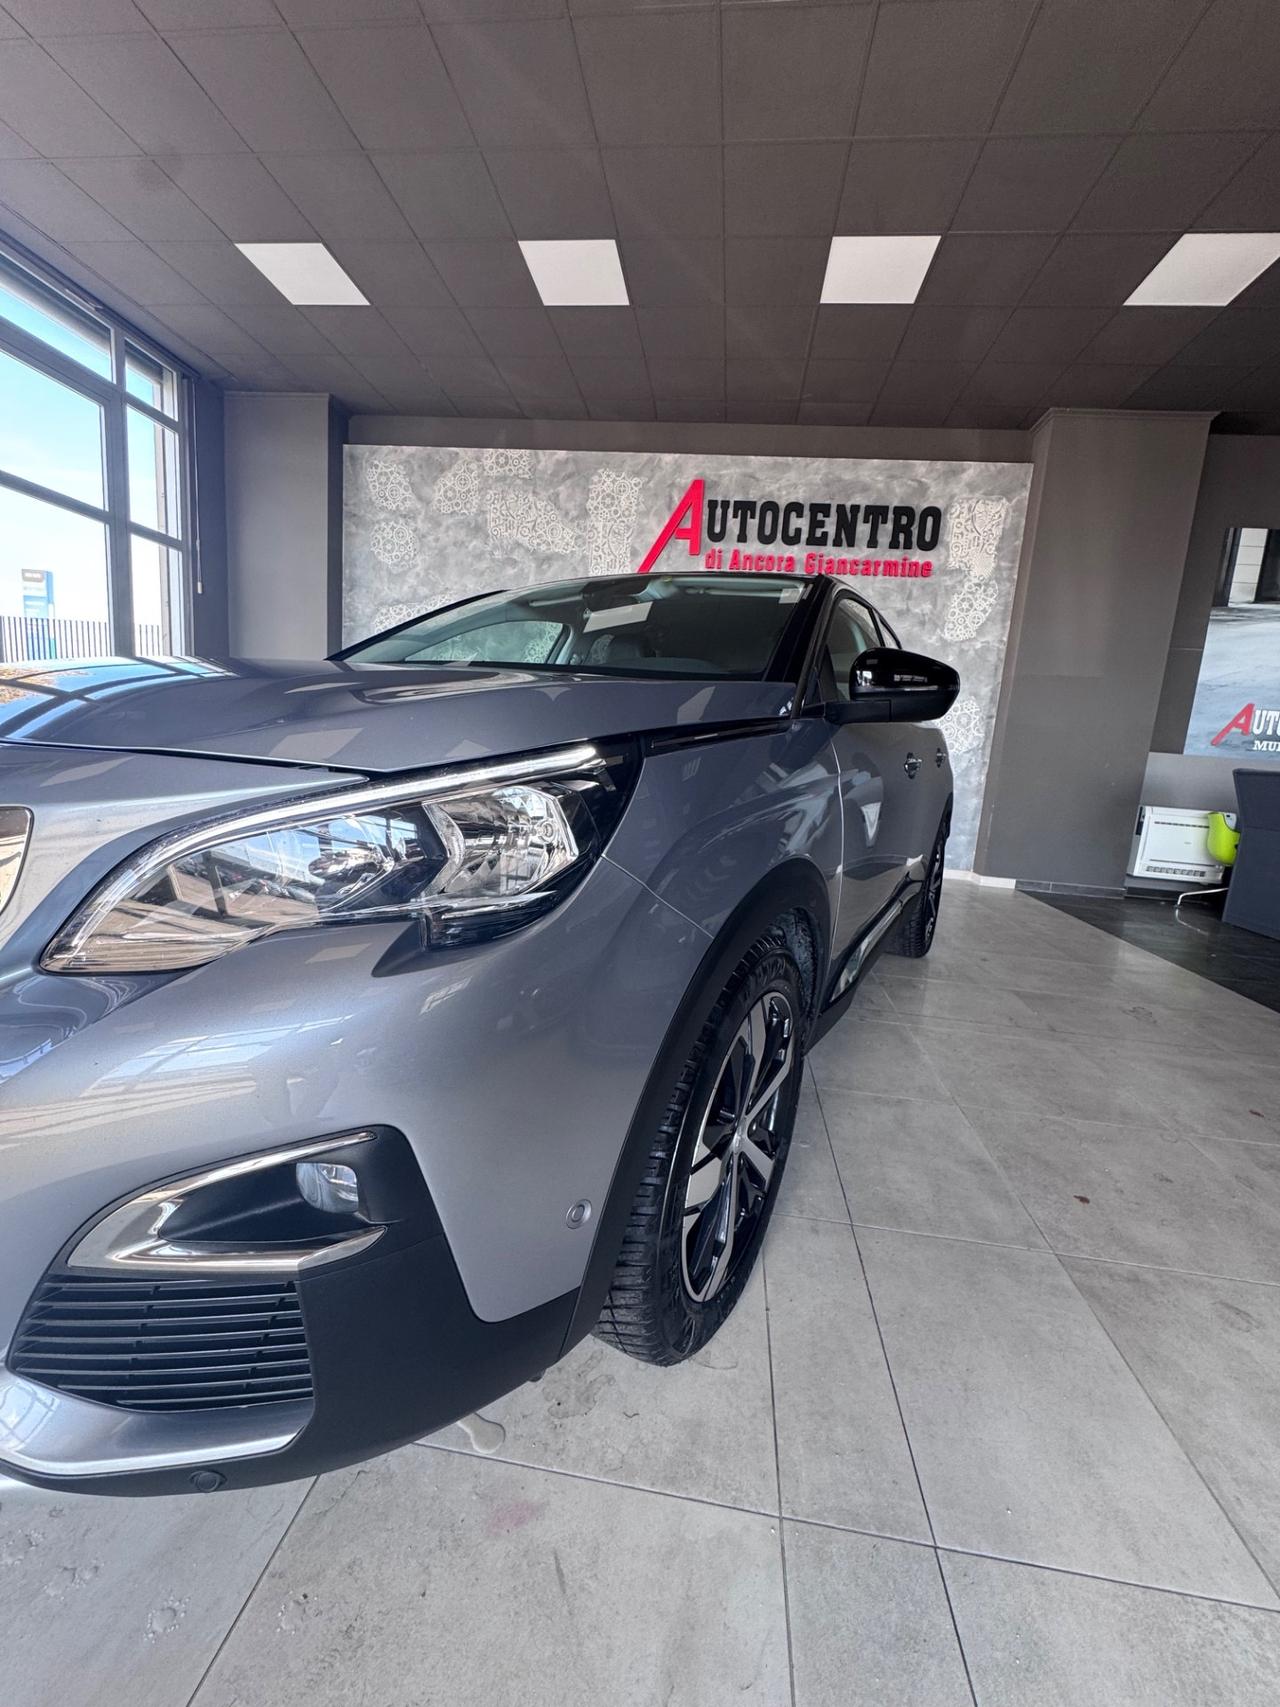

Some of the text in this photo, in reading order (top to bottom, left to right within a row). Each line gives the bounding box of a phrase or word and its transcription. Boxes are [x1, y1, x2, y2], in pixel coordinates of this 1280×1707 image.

[637, 479, 942, 573] AUTOCENTRO
[705, 549, 933, 578] di Ancora Giancarmine
